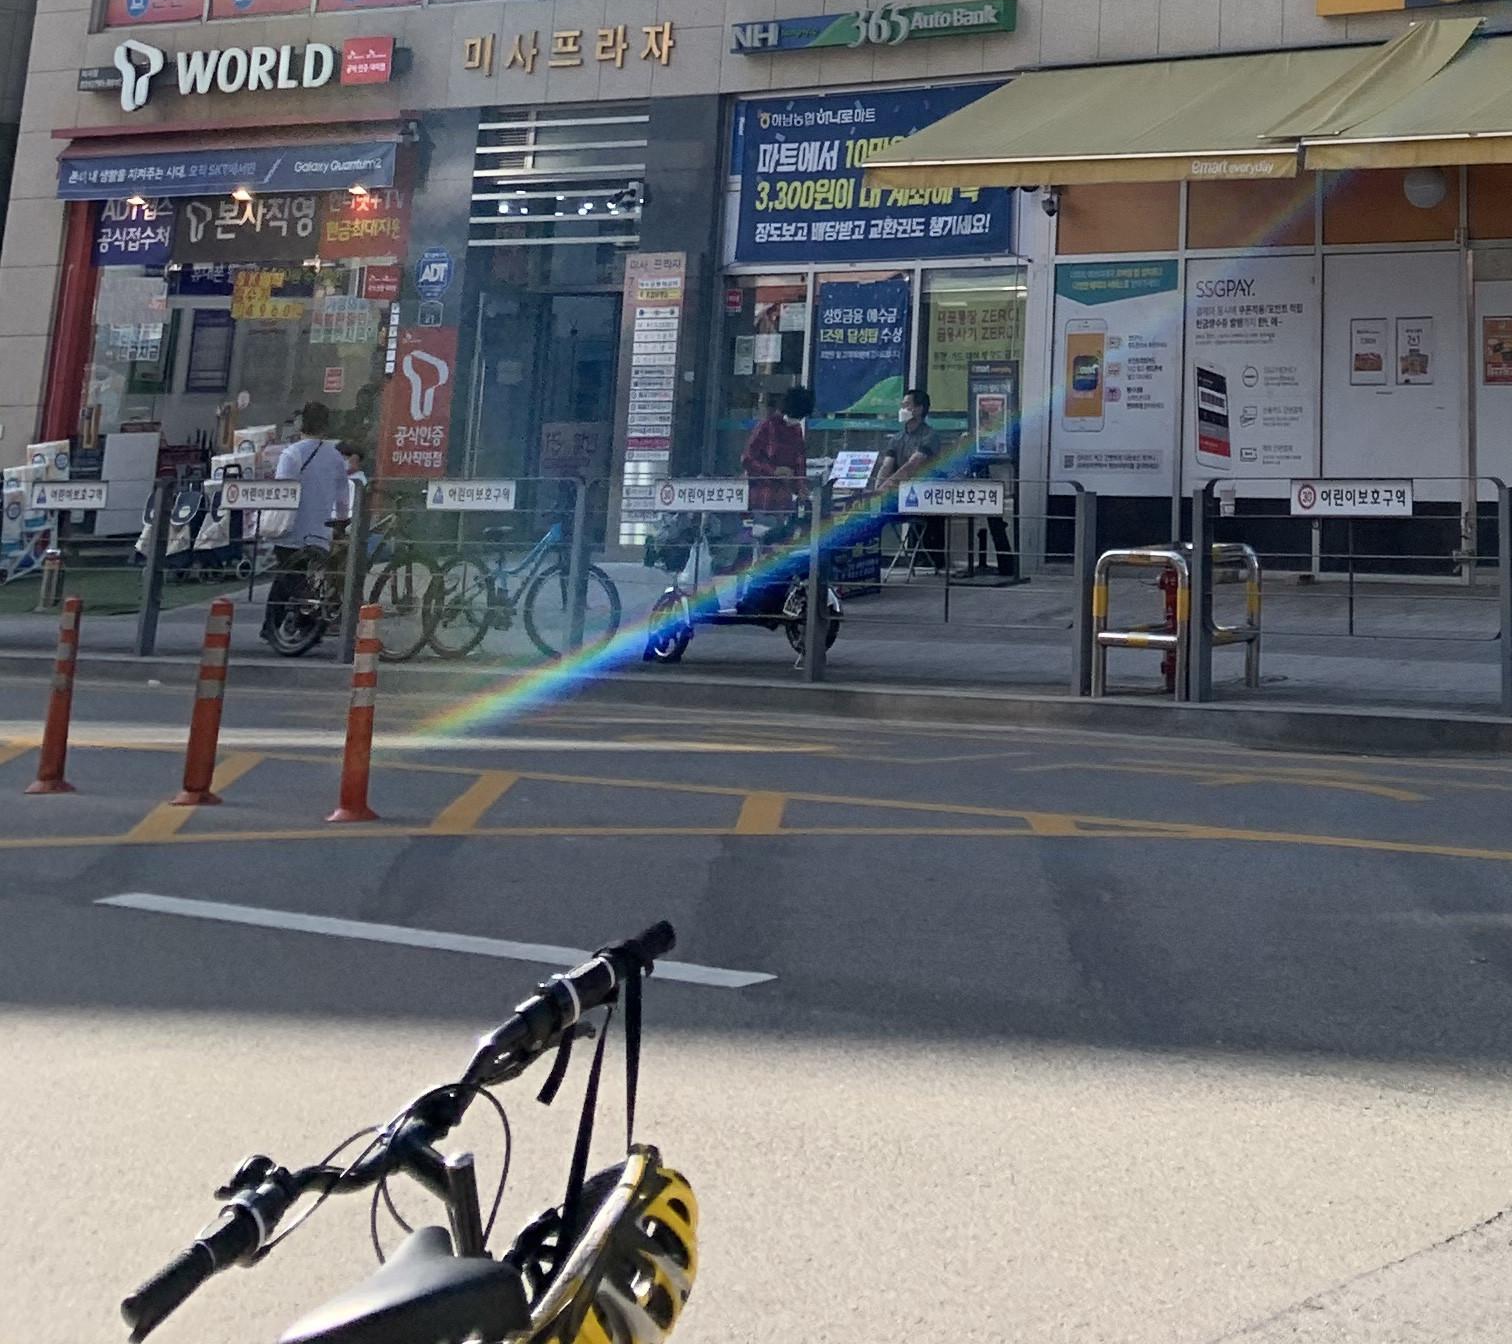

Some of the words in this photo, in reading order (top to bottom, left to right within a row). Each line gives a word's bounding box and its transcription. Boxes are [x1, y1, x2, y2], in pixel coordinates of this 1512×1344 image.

[730, 21, 779, 53] NH
[850, 2, 911, 48] 365
[951, 2, 1000, 29] Bank
[463, 20, 677, 78] 미사프라자
[176, 42, 335, 96] WORLD
[293, 160, 330, 174] Galaxy
[757, 140, 839, 173] 마트에서
[213, 194, 317, 242] 본사직영
[96, 224, 171, 255] 공식접수처
[419, 262, 448, 283] ADT
[393, 425, 445, 448] 공식인증
[448, 485, 511, 503] 어린이보호구역
[677, 486, 745, 504] 어린이보호구역
[923, 488, 998, 507] 어린이보호구역
[1320, 487, 1407, 508] 어린이보호구역
